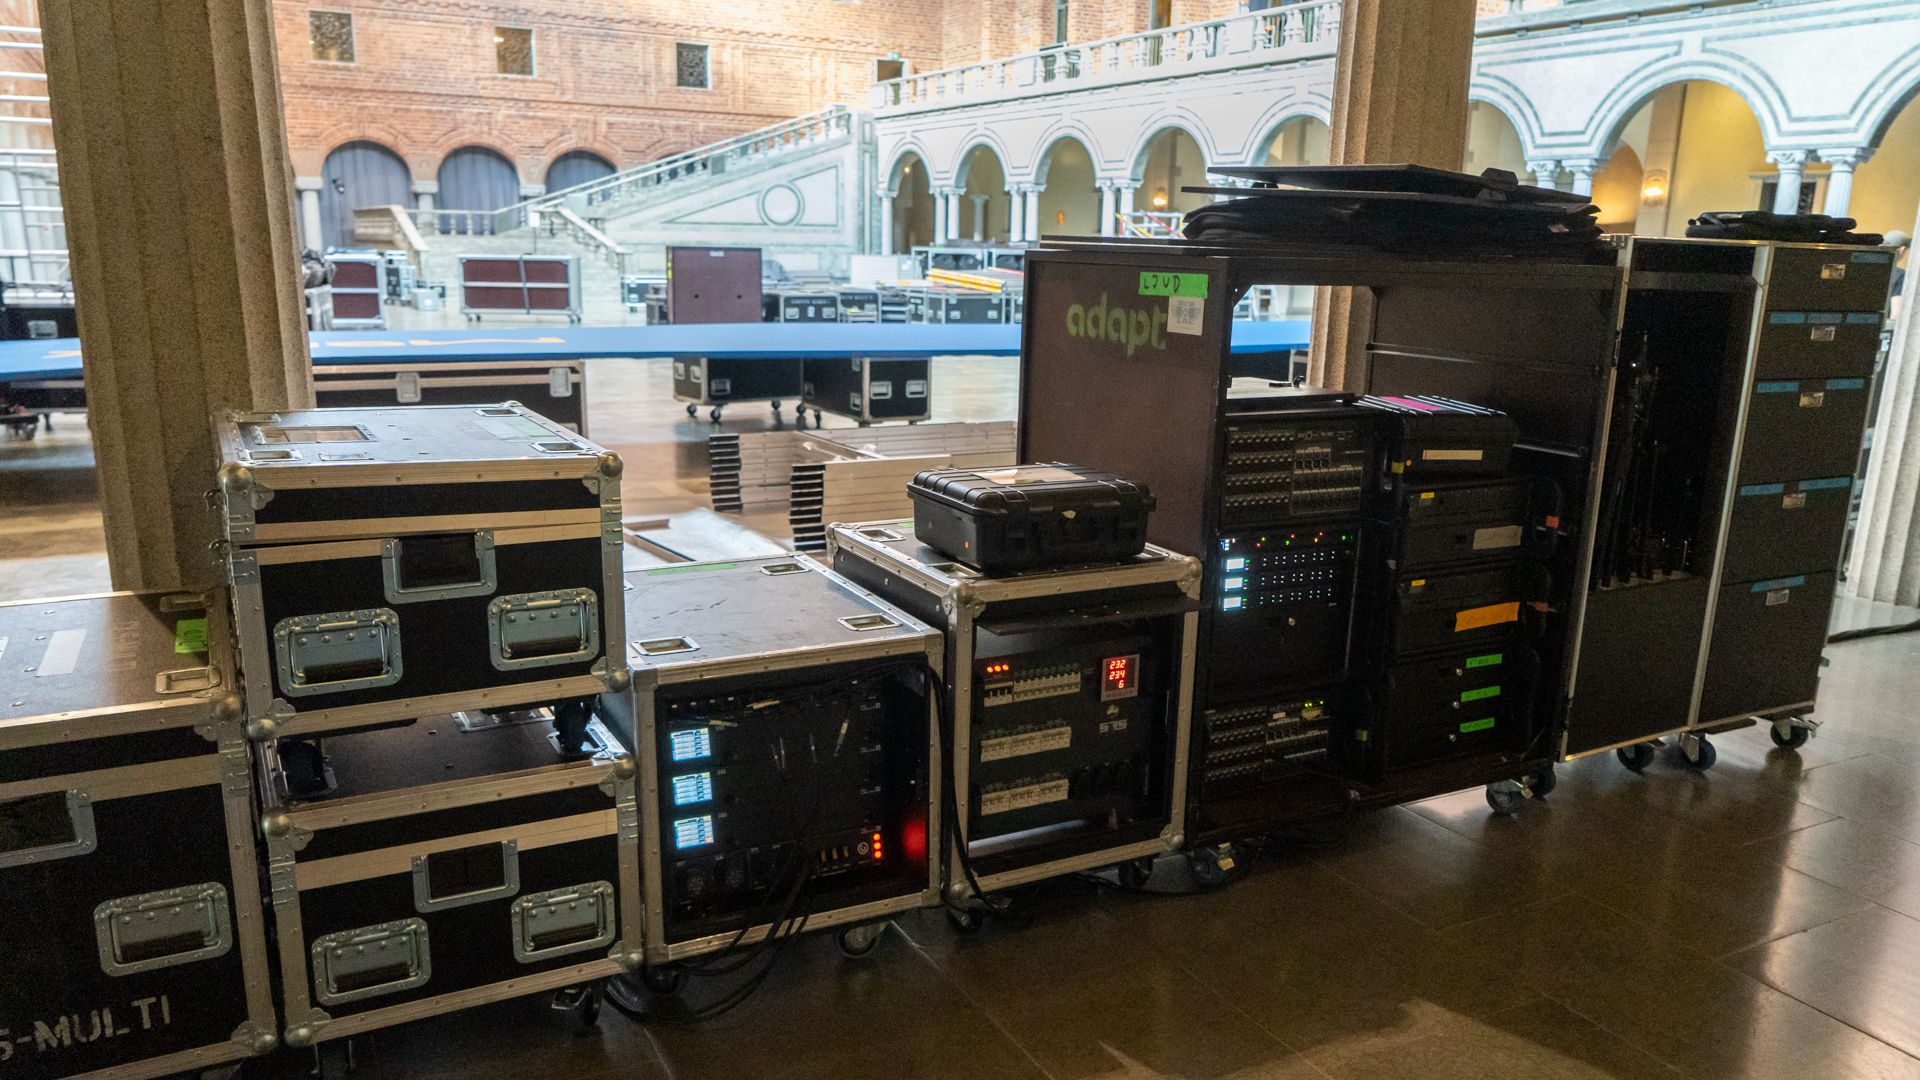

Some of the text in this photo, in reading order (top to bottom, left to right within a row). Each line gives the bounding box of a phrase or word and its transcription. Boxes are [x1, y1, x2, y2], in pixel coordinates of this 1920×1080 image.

[1066, 291, 1168, 358] adapt
[1109, 659, 1126, 670] 232
[1108, 669, 1126, 680] 234
[1118, 680, 1125, 689] 6
